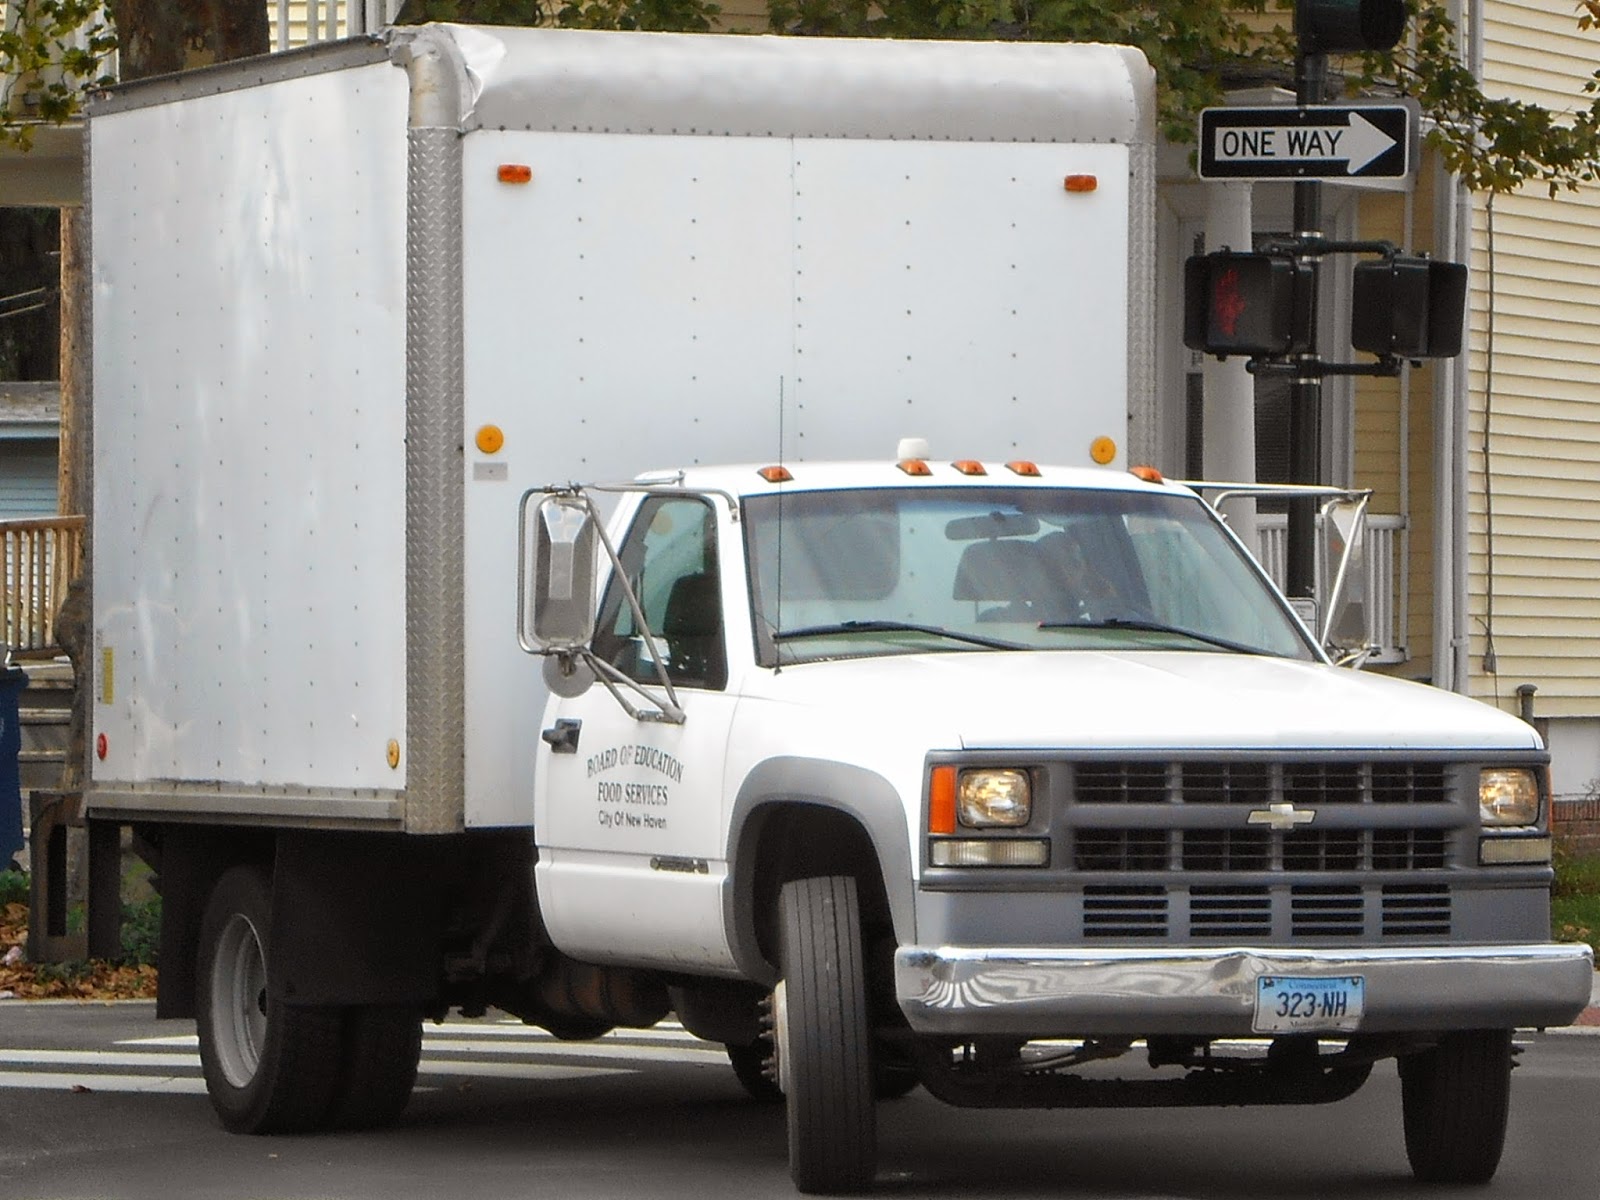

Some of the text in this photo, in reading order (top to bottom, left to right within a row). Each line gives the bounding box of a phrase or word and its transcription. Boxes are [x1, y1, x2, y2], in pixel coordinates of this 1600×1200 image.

[1222, 130, 1344, 156] ONE WAY
[587, 744, 684, 784] BOARD OF EDUCATION
[598, 782, 668, 806] FOOD SERVICES
[598, 810, 668, 830] City Of New Haven
